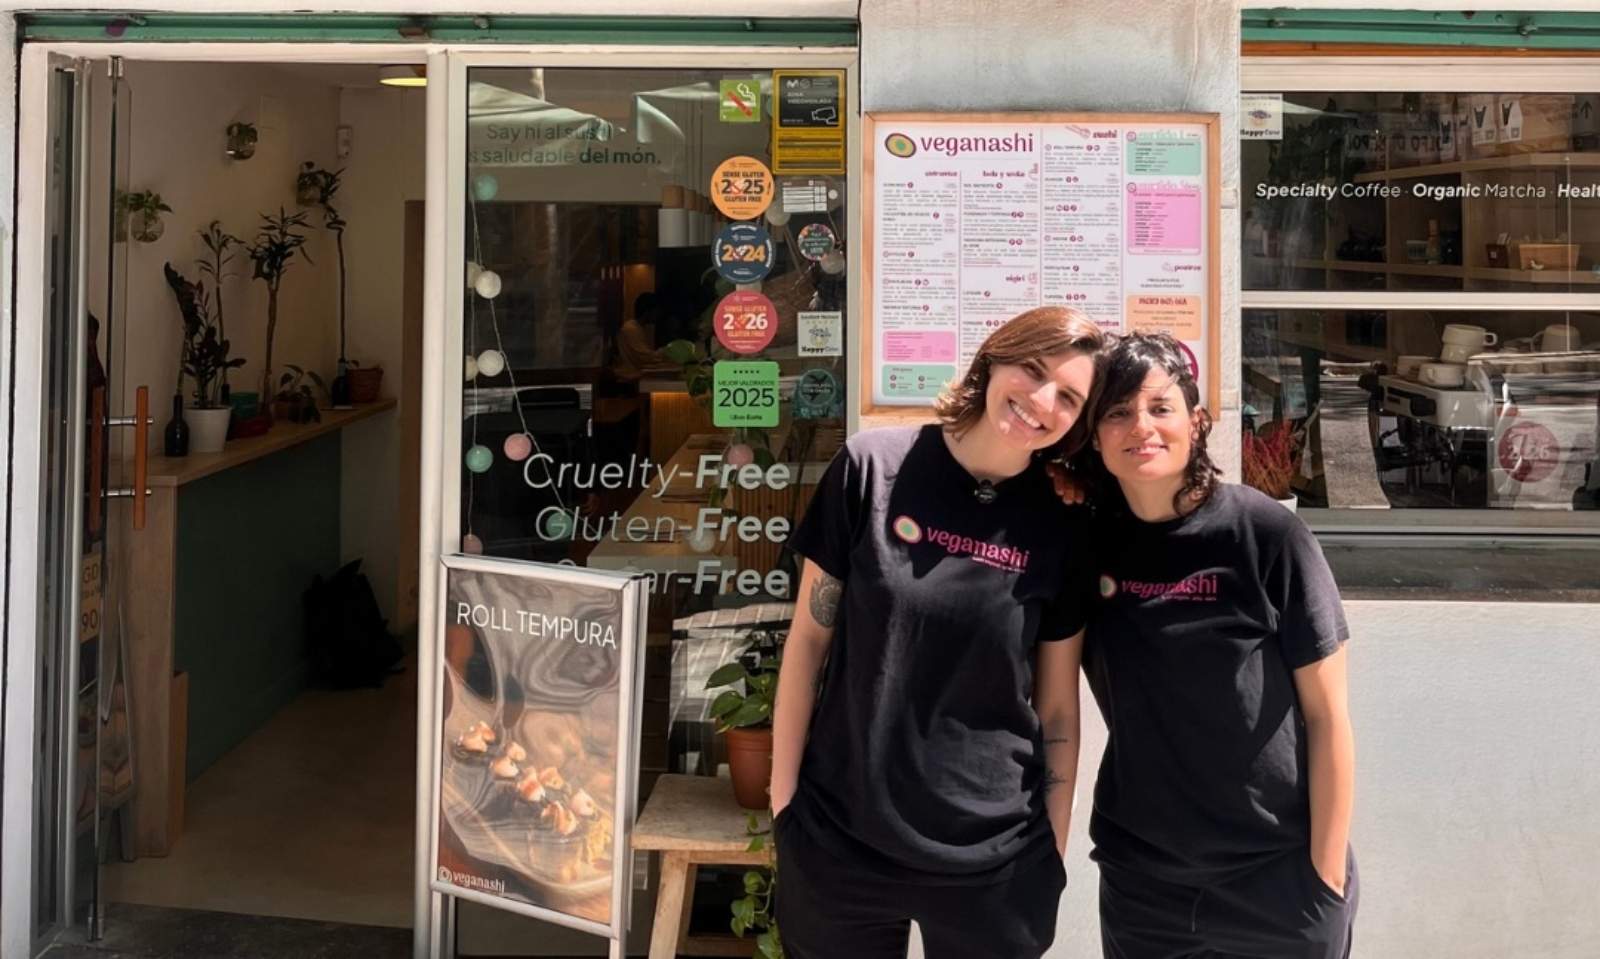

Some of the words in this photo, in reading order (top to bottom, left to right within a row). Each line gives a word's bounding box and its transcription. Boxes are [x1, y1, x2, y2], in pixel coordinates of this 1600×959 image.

[487, 125, 520, 143] Say
[525, 125, 540, 140] hi
[545, 125, 559, 140] al
[564, 125, 611, 140] susi
[920, 133, 1033, 156] veganashi
[483, 147, 574, 164] saludable
[580, 147, 608, 163] del
[613, 147, 661, 164] món.
[1255, 183, 1338, 200] Specialty
[1341, 183, 1401, 197] Coffee
[1413, 183, 1481, 200] Organic
[1485, 183, 1546, 198] Matcha
[718, 387, 775, 407] 2025
[523, 452, 791, 498] Cruelty-Free
[535, 506, 791, 543] Gluten-Free
[927, 527, 1030, 567] veganashi
[557, 559, 790, 596] ar-Free
[457, 602, 512, 632] ROLL
[516, 610, 617, 650] TEMPURA
[452, 871, 505, 894] veganashi
